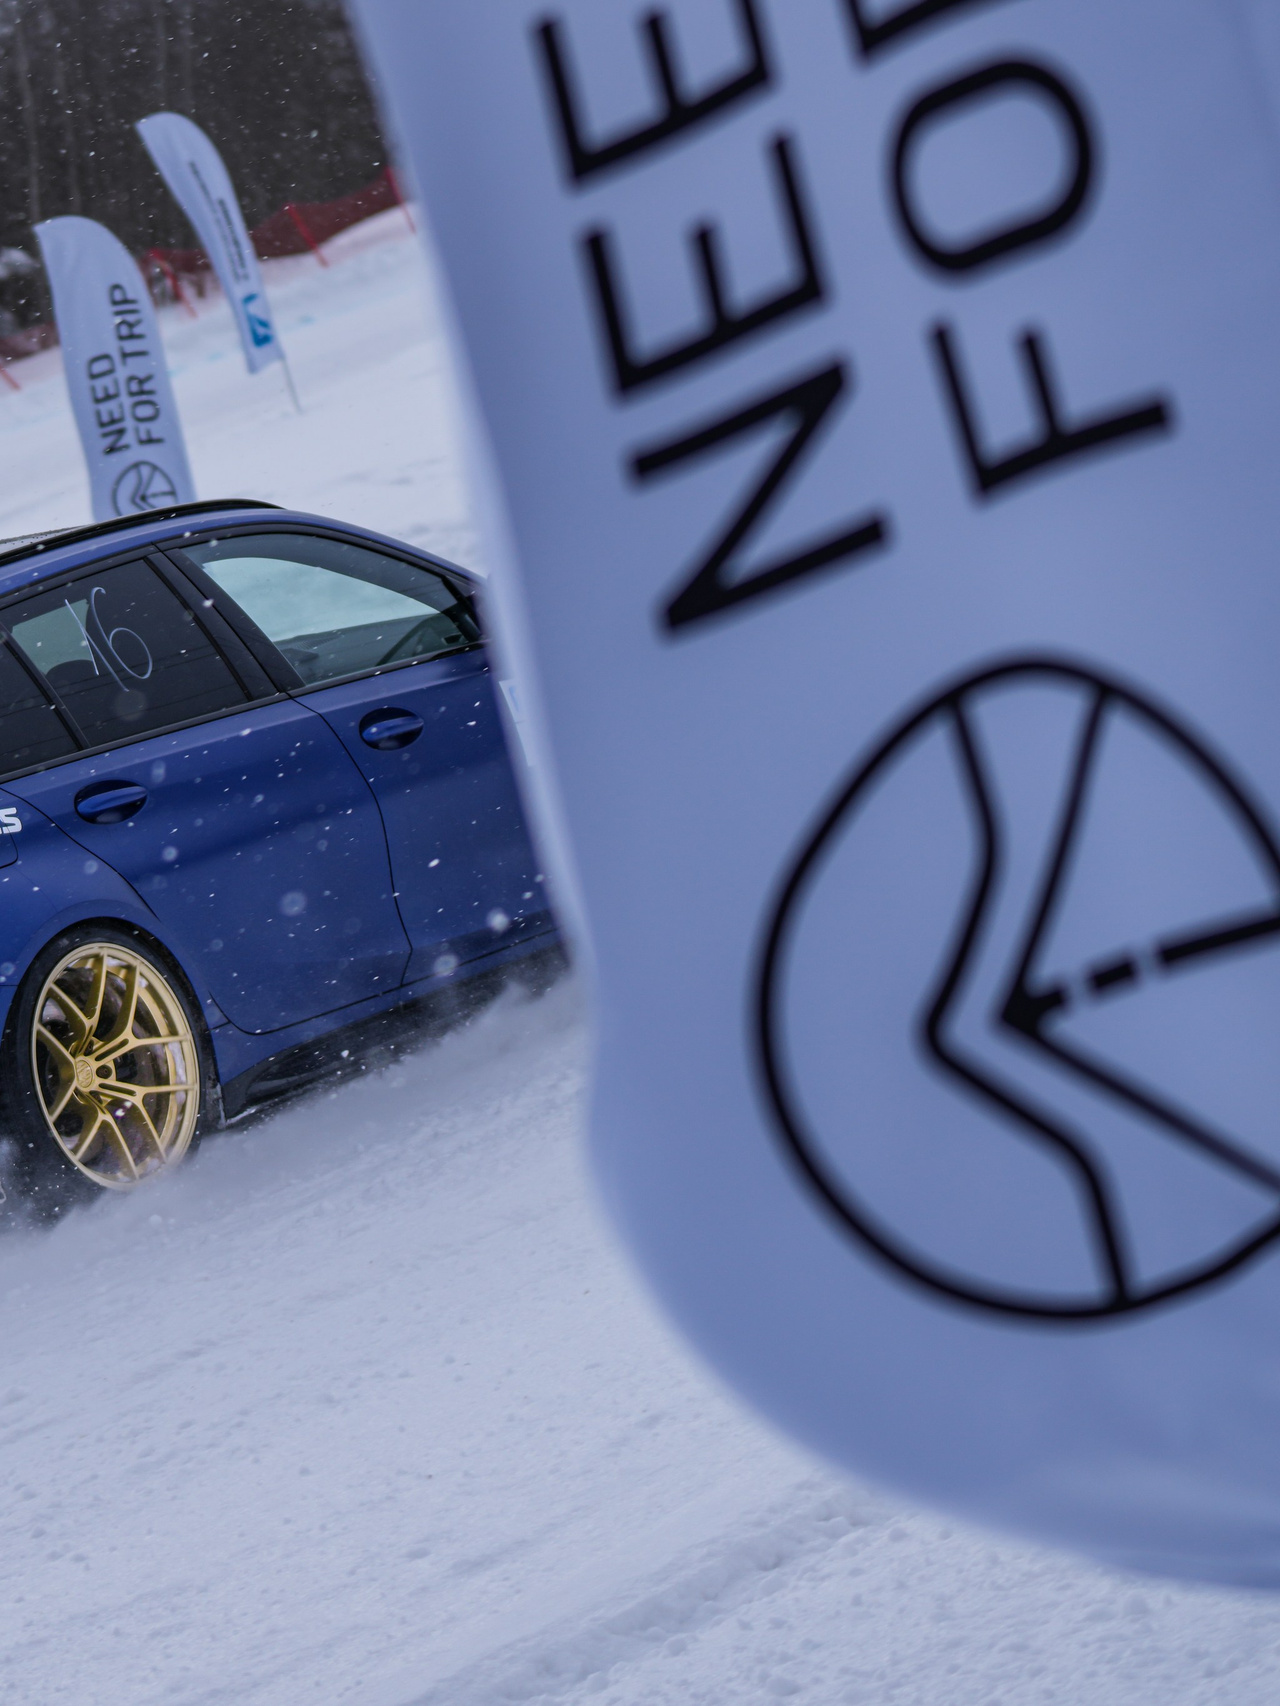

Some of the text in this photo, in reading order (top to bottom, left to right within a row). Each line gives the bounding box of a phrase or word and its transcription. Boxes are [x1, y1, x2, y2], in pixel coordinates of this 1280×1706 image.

[837, 0, 1174, 503] FO
[87, 353, 131, 455] NEED
[109, 284, 166, 446] FOR TRIP
